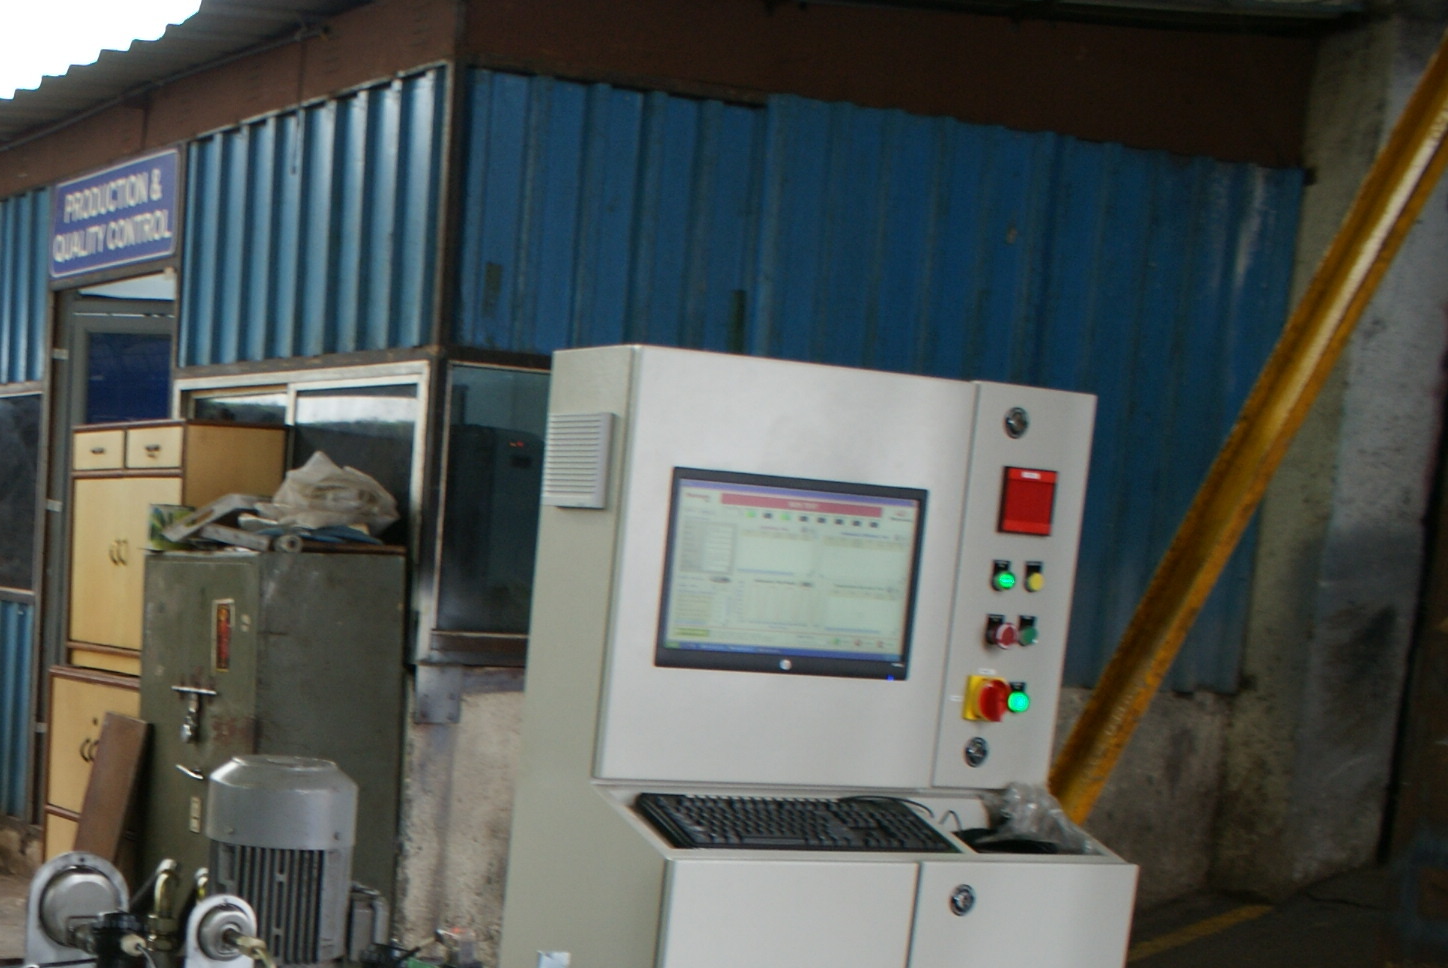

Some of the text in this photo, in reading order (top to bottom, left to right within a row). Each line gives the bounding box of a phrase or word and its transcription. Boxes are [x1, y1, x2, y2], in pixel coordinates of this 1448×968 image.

[63, 168, 162, 224] PRODUCTION &
[53, 209, 172, 263] QUALITY CONTROL
